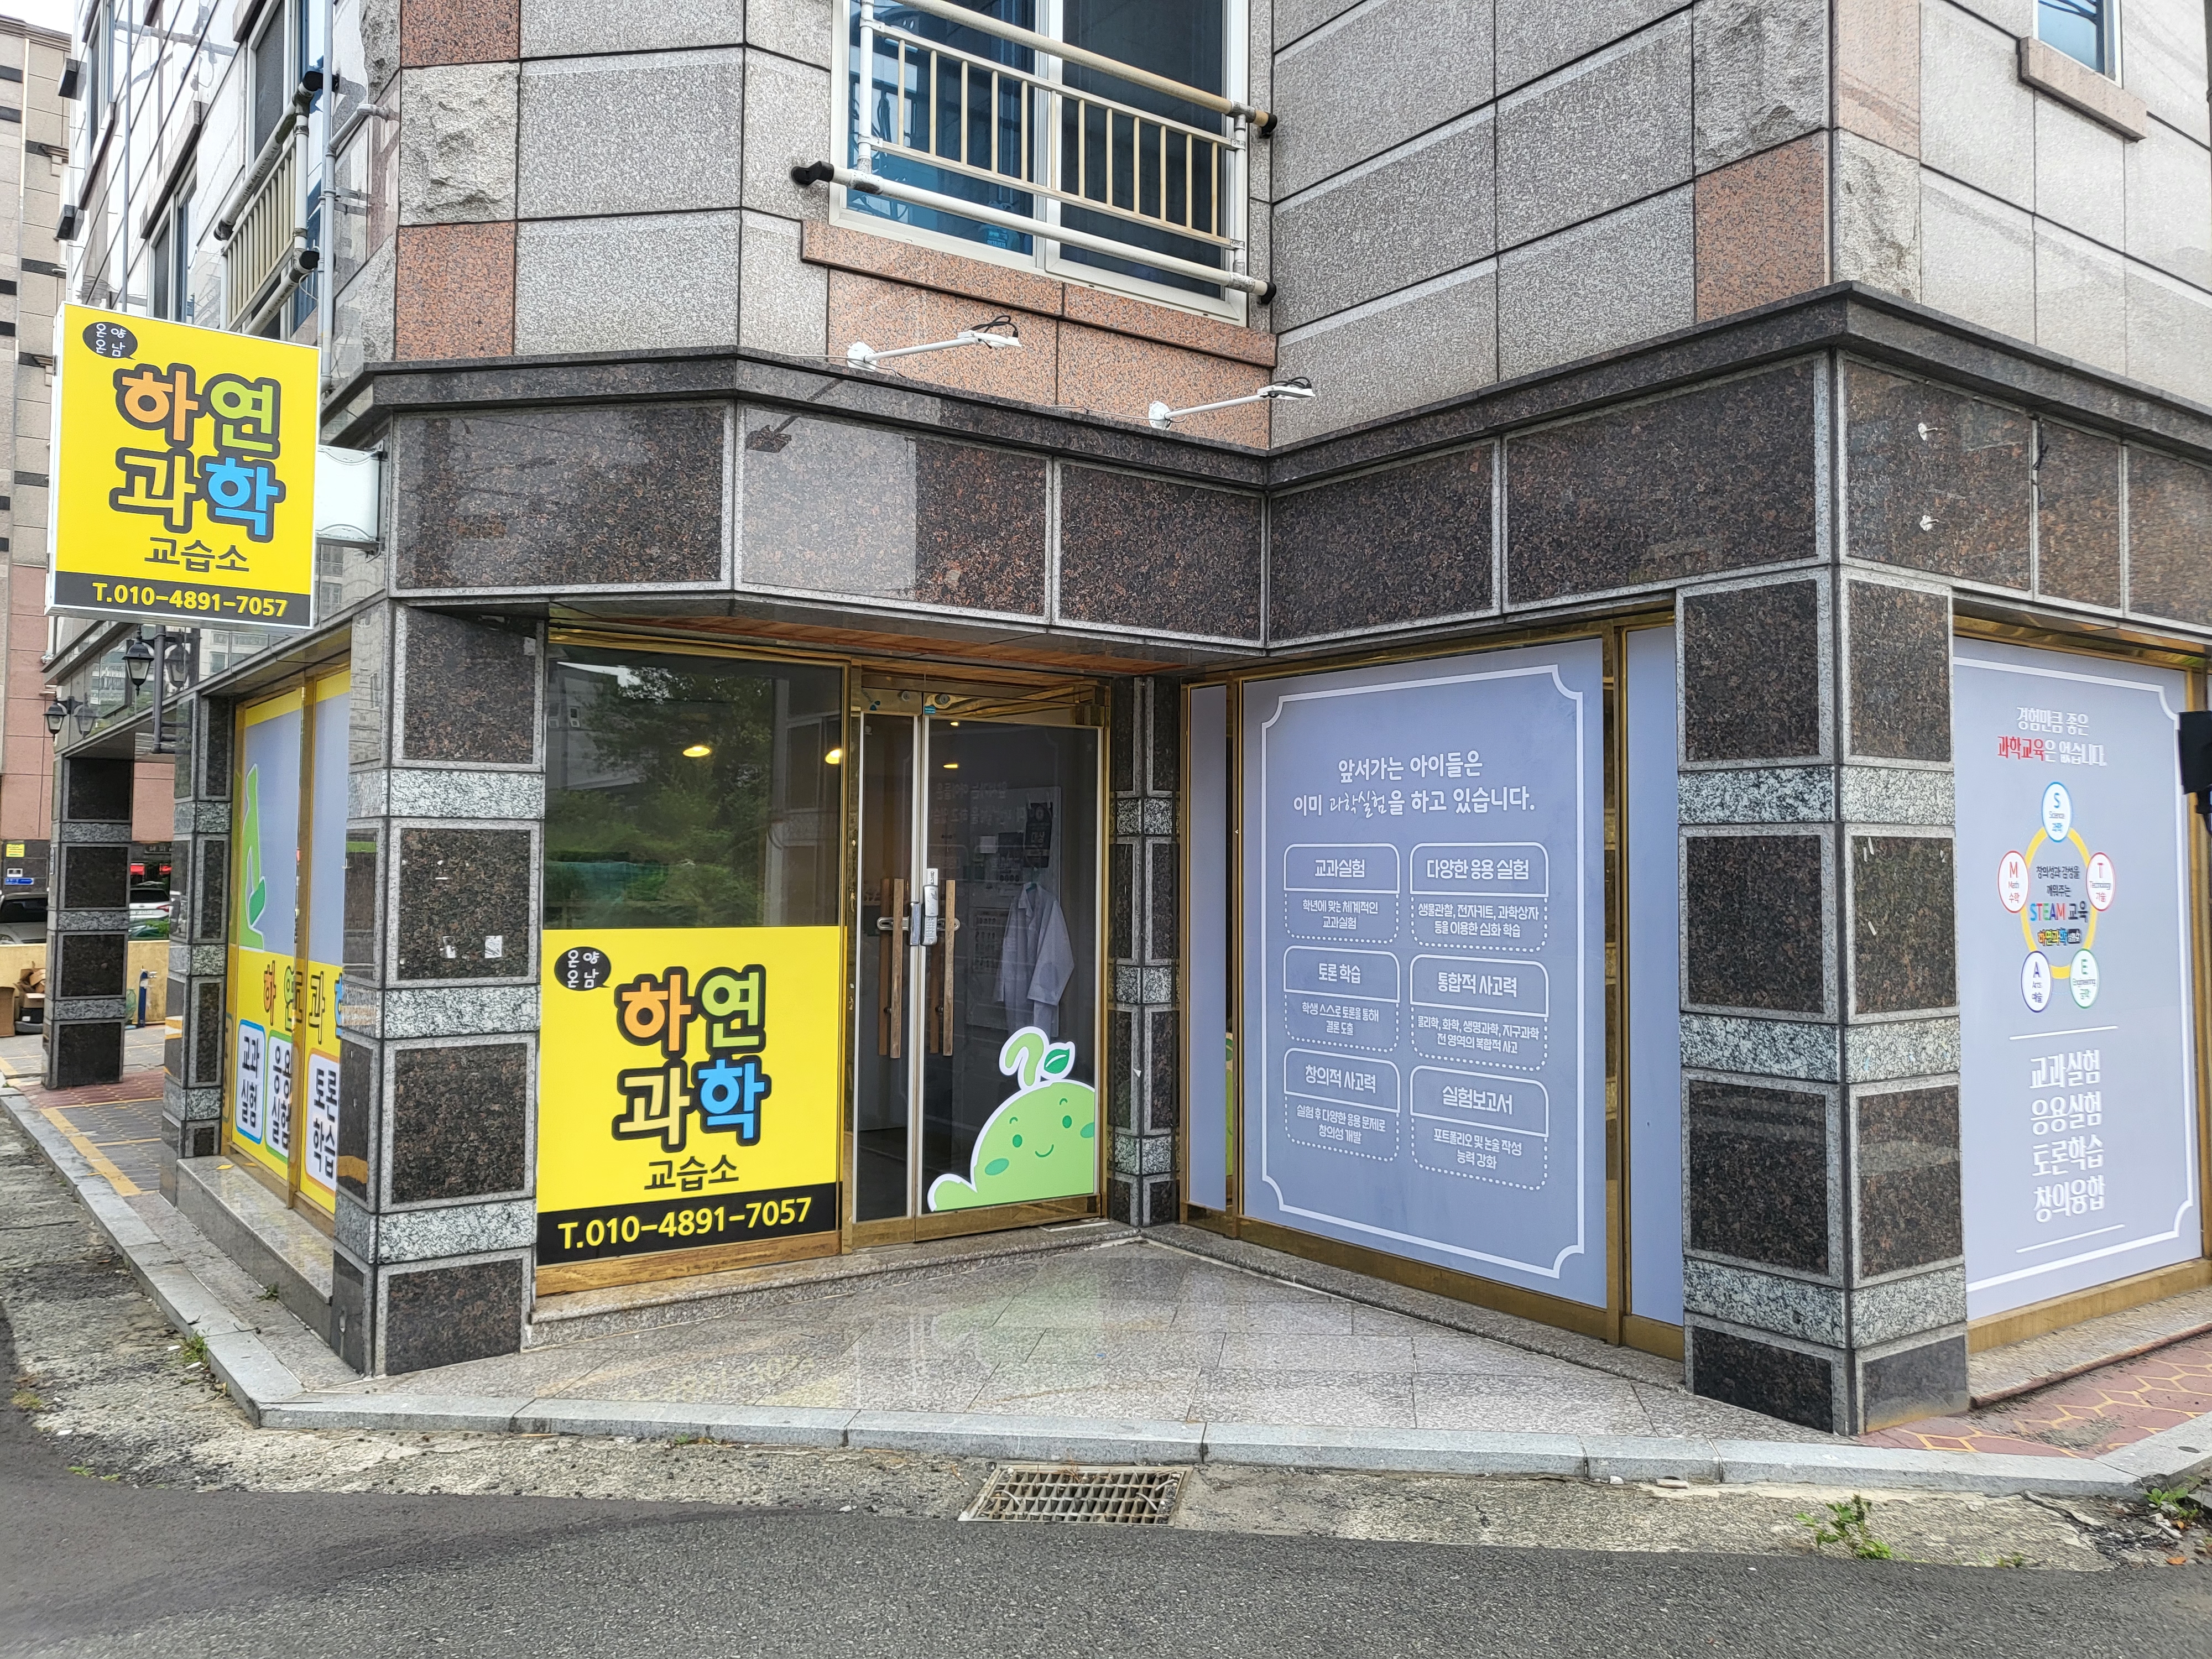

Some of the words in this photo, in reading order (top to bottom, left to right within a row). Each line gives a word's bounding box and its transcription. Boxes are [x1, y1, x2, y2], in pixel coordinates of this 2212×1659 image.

[96, 323, 127, 338] 온양
[95, 339, 126, 357] 온남
[118, 367, 276, 456] 하연
[114, 452, 282, 538] 과학
[144, 537, 249, 572] 교습소
[92, 582, 288, 617] T.010-4891-7057
[2017, 707, 2063, 733] 경험만큼
[2066, 712, 2089, 735] 좋은
[1997, 736, 2057, 763] 과학교육은
[2059, 741, 2107, 766] 없습니다.
[1338, 757, 1404, 783] 앞서가는
[1410, 750, 1483, 778] 아이들은
[1293, 794, 1322, 816] 이미
[1329, 790, 1405, 818] 과학실험을
[1411, 790, 1447, 813] 하고
[1453, 786, 1535, 813] 있습니다.
[2053, 792, 2061, 808] S
[1314, 859, 1365, 878] 교과실험
[1427, 859, 1468, 879] 다양한
[1471, 859, 1494, 880] 응용
[1496, 859, 1528, 880] 실험
[2009, 862, 2019, 878] M
[2036, 865, 2061, 879] 창의성과
[2062, 865, 2080, 879] 감성을
[2097, 863, 2105, 879] T
[1302, 899, 1327, 912] 학년에
[1328, 900, 1342, 912] 맞는
[1342, 901, 1378, 914] 체계적인
[2008, 893, 2020, 903] 수학
[1323, 916, 1357, 930] 교과실험
[1418, 904, 1455, 919] 생물관찰,
[1458, 904, 1496, 920] 전자키트,
[1498, 905, 1539, 920] 과학상자
[2030, 902, 2065, 921] STEAM
[2068, 900, 2088, 923] 교육
[1434, 921, 1449, 934] 등을
[1450, 921, 1478, 936] 이용한
[1480, 922, 1501, 937] 심화
[1503, 923, 1521, 938] 학습
[567, 950, 600, 968] 온양
[2033, 962, 2042, 978] A
[2081, 959, 2088, 974] E
[567, 969, 600, 988] 온남
[1318, 963, 1337, 982] 토론
[1339, 964, 1360, 984] 학습
[1438, 972, 1476, 994] 통합적
[1479, 975, 1517, 998] 사고력
[2032, 992, 2043, 1003] 예술
[618, 969, 762, 1054] 하연
[1302, 1001, 1318, 1015] 학생
[1319, 1004, 1342, 1018] 스스로
[1342, 1006, 1361, 1020] 토론을
[1362, 1008, 1379, 1022] 통해
[1326, 1020, 1340, 1034] 결론
[1341, 1022, 1353, 1036] 도출
[1418, 1015, 1441, 1031] 물리학,
[1442, 1018, 1462, 1033] 화학,
[1463, 1020, 1501, 1037] 생명과학,
[1503, 1025, 1540, 1040] 지구과학
[1437, 1033, 1446, 1045] 전
[1447, 1034, 1475, 1048] 영역의
[1476, 1037, 1501, 1052] 복합적
[1503, 1041, 1517, 1053] 사고
[242, 1036, 259, 1079] 교과
[2029, 1049, 2100, 1088] 교과실험
[1305, 1065, 1341, 1088] 창의적
[1344, 1071, 1375, 1094] 사고력
[241, 1079, 258, 1129] 실험
[314, 1068, 337, 1123] 토론
[616, 1056, 768, 1148] 과학
[1442, 1086, 1512, 1115] 실험보고서
[1297, 1104, 1313, 1119] 실험
[1314, 1107, 1321, 1120] 후
[1322, 1109, 1346, 1125] 다양한
[1347, 1113, 1361, 1128] 응용
[1362, 1116, 1386, 1132] 문제로
[2030, 1091, 2102, 1135] 응용실험
[1319, 1124, 1343, 1141] 창의성
[1345, 1129, 1362, 1144] 개발
[1433, 1128, 1473, 1147] 포트폴리오
[1474, 1135, 1483, 1149] 및
[1484, 1136, 1500, 1152] 논술
[1501, 1140, 1521, 1156] 작성
[313, 1117, 336, 1180] 학습
[1457, 1149, 1475, 1166] 능력
[1476, 1152, 1497, 1170] 강화
[2032, 1134, 2104, 1176] 토론학습
[644, 1155, 739, 1192] 교습소
[2033, 1174, 2106, 1223] 창의융합
[557, 1197, 812, 1249] T.010-4891-7057
